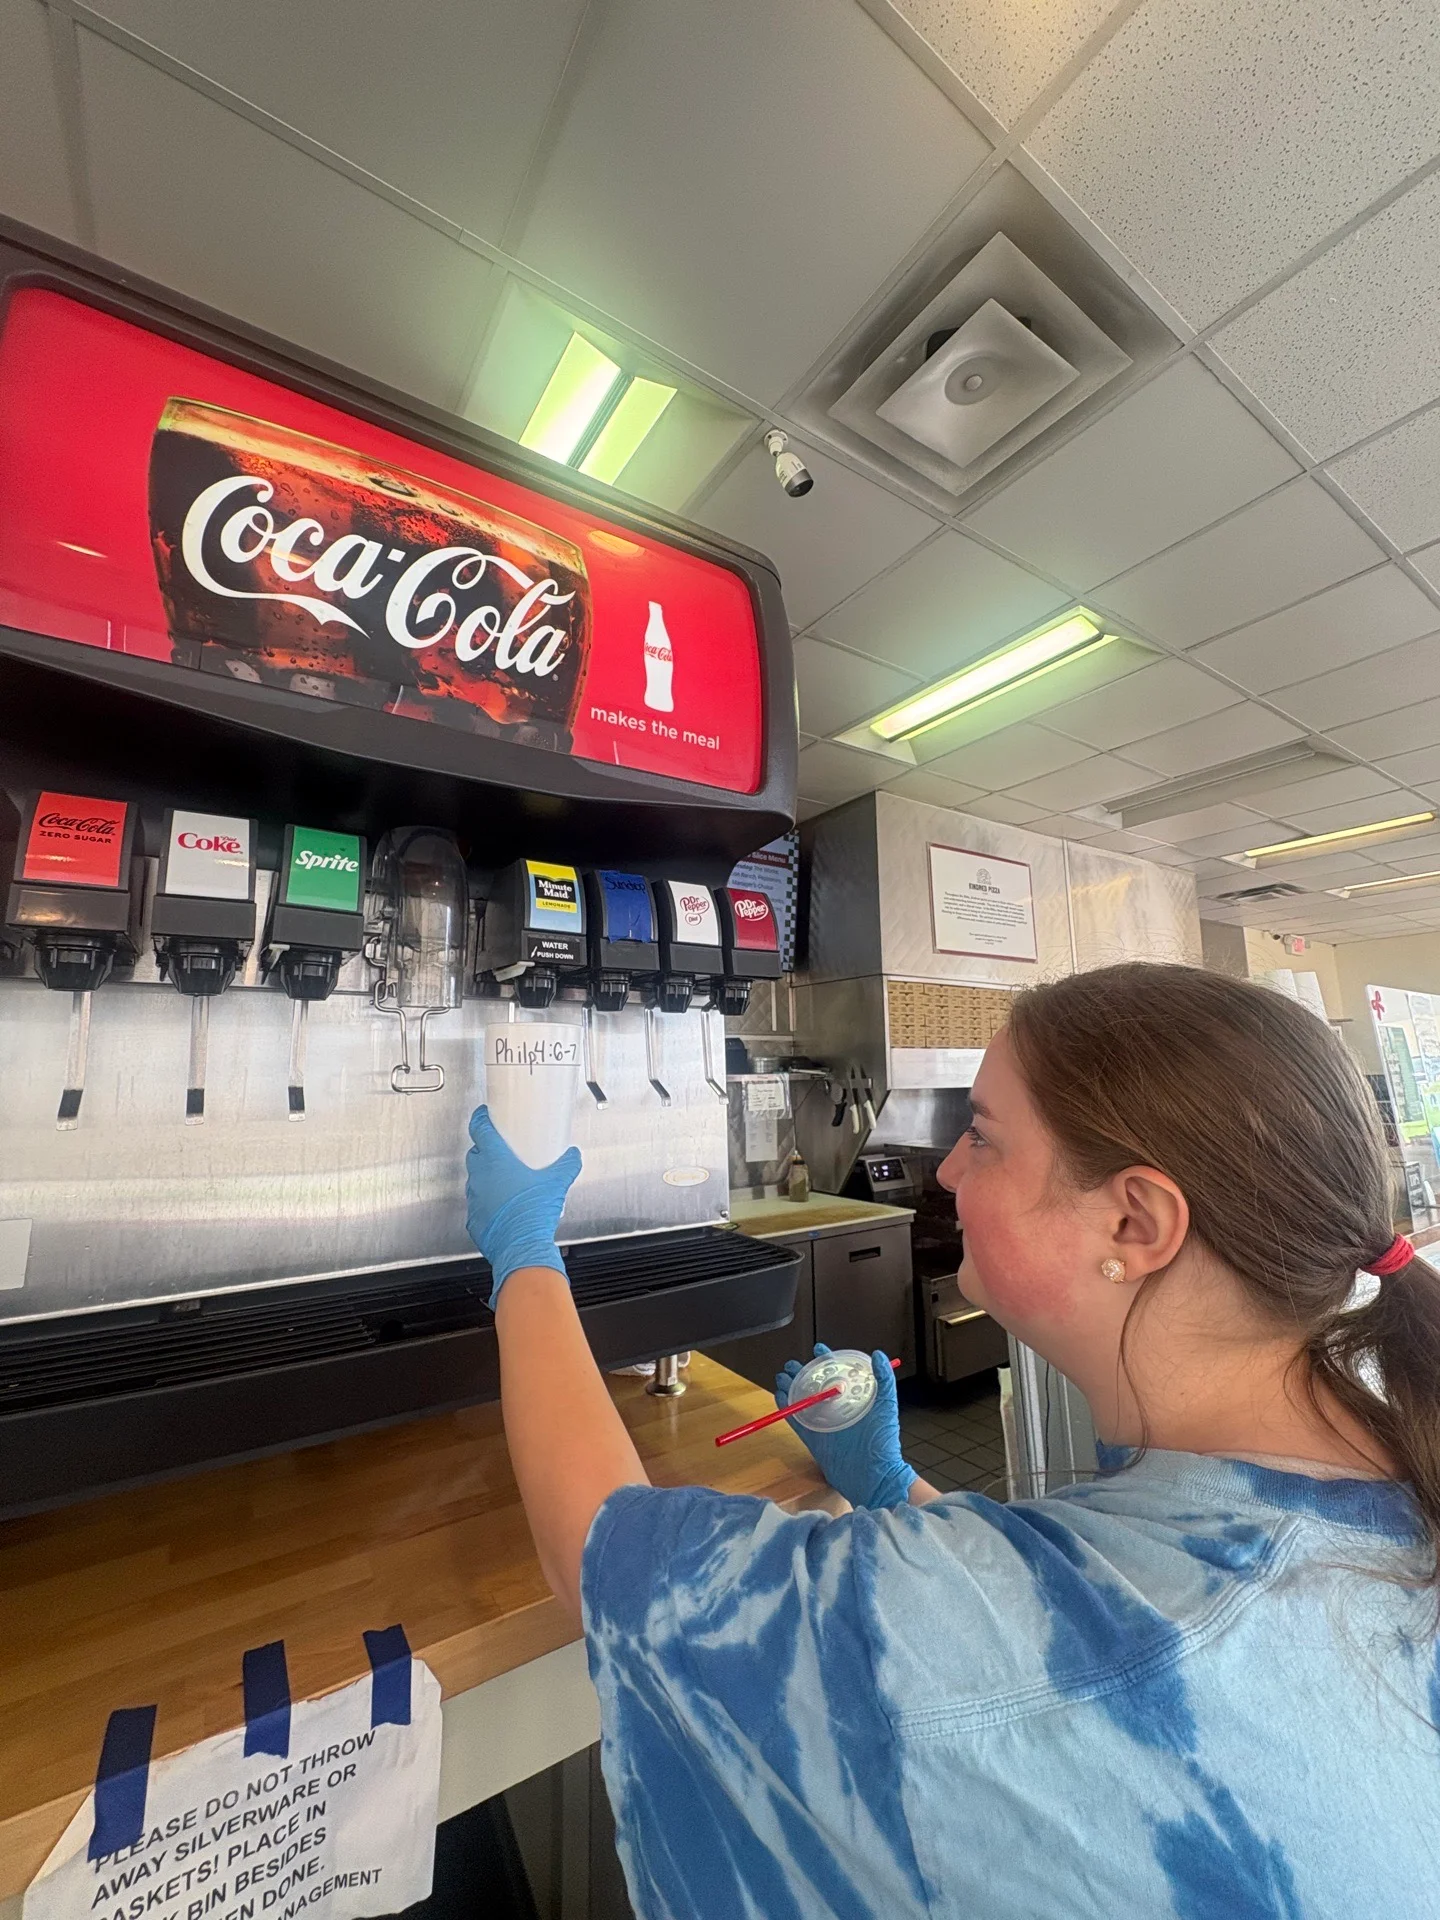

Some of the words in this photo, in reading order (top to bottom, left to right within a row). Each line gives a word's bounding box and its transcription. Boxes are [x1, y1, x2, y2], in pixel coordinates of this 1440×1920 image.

[181, 475, 576, 678] Coca-Cola
[590, 707, 647, 732] makes
[651, 720, 679, 740] the
[682, 731, 720, 750] meal
[38, 812, 119, 835] Coca-Cola
[40, 830, 70, 839] ZERO
[74, 834, 112, 844] SUGAR
[177, 832, 242, 854] Coke
[295, 850, 359, 872] Sprite
[538, 880, 572, 892] Minute
[544, 888, 569, 899] Maid
[988, 886, 1000, 894] PIZZA
[542, 901, 571, 909] LEMONADE
[681, 897, 707, 912] Pepper
[688, 896, 700, 904] Dr
[737, 900, 766, 918] Pepper
[744, 899, 756, 909] Dr
[541, 941, 569, 950] WATER
[537, 951, 554, 959] PUSH
[555, 952, 574, 960] DOWN
[205, 1790, 239, 1819] DO
[247, 1764, 294, 1801] NOT
[299, 1730, 376, 1774] THROW
[91, 1850, 168, 1911] AWAY
[174, 1777, 321, 1862] SILVERWARE
[327, 1763, 357, 1788] OR
[99, 1854, 219, 1920] ASKETS!
[227, 1812, 300, 1868] PLACE
[306, 1800, 327, 1823] IN
[188, 1882, 227, 1920] BIN
[234, 1826, 327, 1896] BESIDES
[262, 1856, 325, 1911] DONE.
